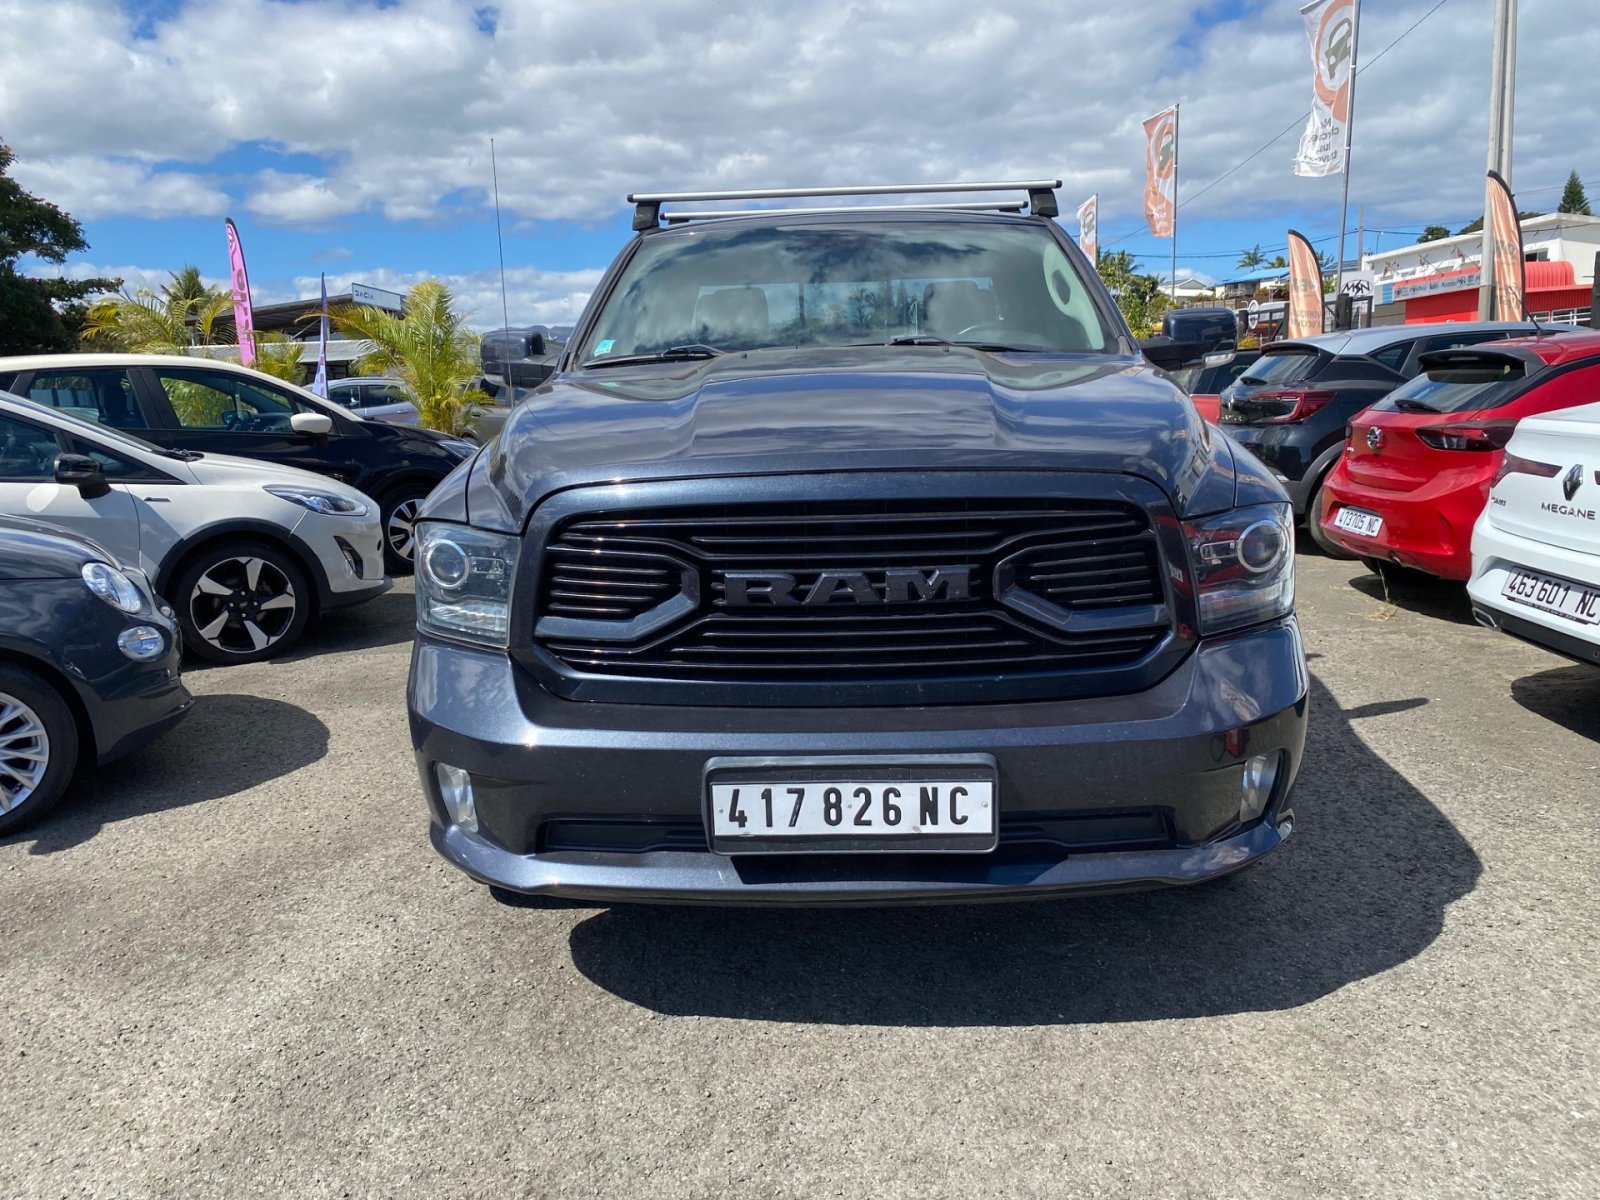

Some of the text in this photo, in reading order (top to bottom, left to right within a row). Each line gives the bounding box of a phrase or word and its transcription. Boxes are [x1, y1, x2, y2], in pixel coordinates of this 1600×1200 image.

[355, 289, 375, 300] DACIA
[1541, 502, 1597, 520] MEGANE
[724, 567, 969, 605] RAM
[1508, 572, 1539, 598] 463
[1536, 580, 1571, 608] 601
[1574, 590, 1600, 617] NC
[728, 786, 968, 828] 417 826 NC
